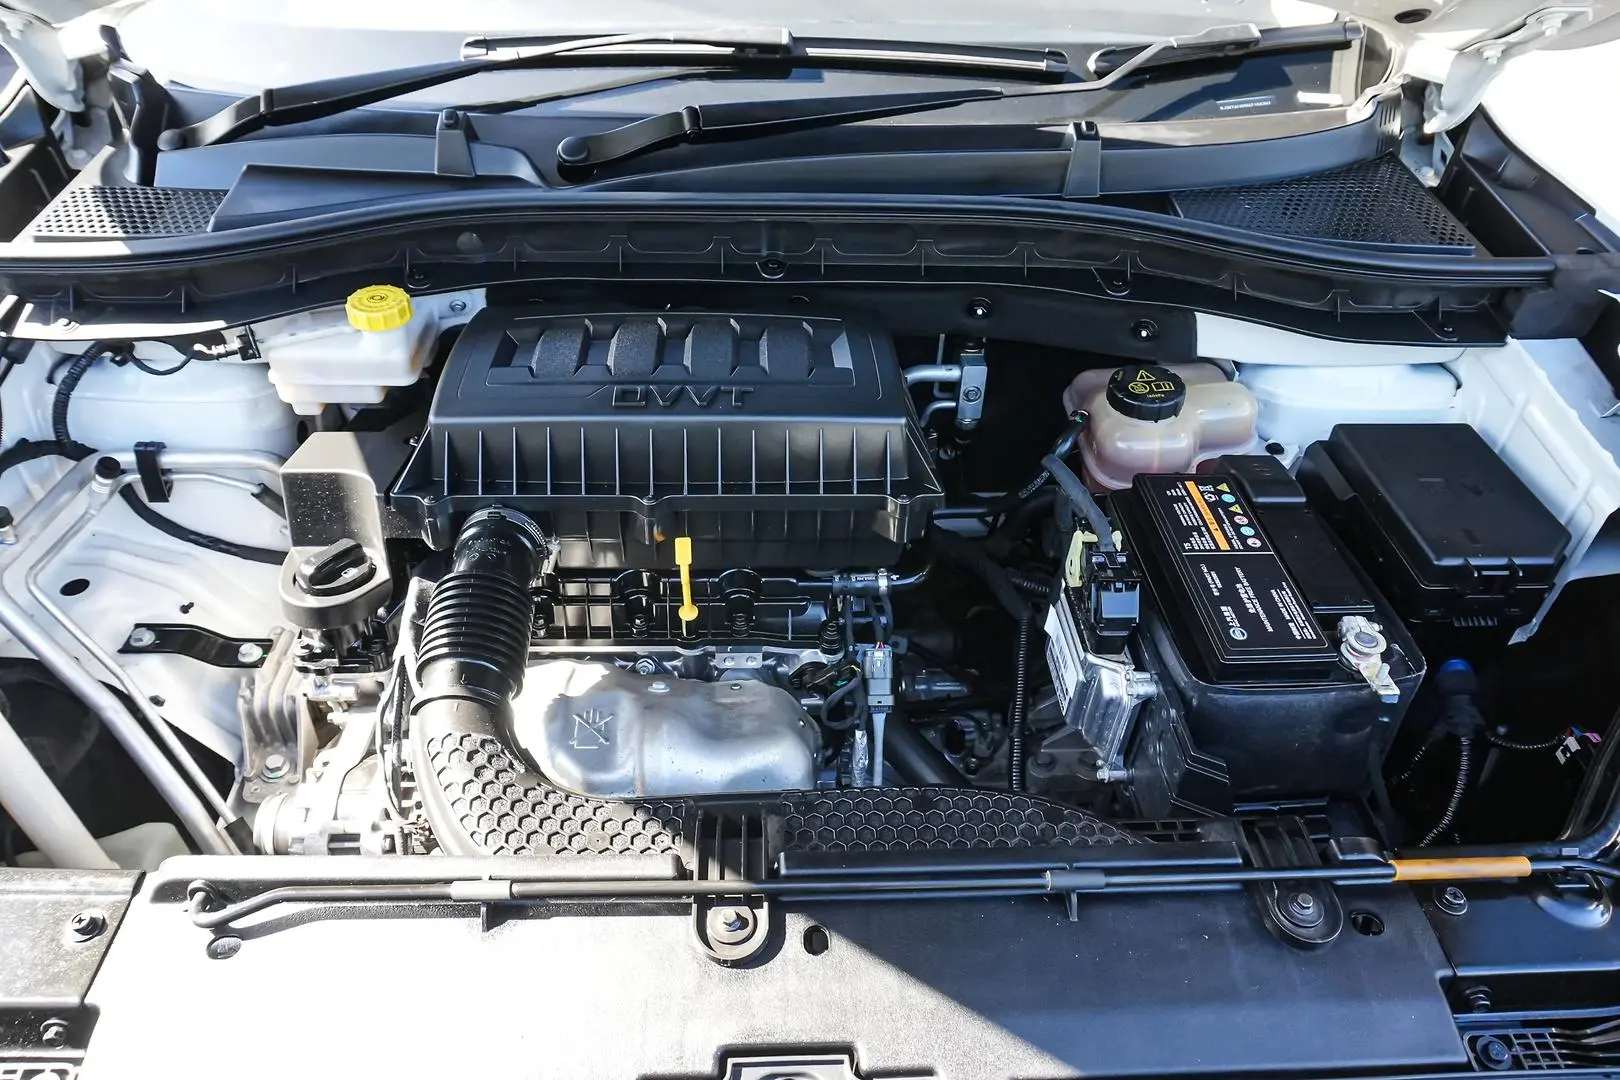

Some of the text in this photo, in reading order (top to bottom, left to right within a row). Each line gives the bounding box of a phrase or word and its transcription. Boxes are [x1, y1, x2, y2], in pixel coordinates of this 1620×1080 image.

[612, 384, 754, 408] DVVT
[1234, 566, 1249, 585] BATTERY
[1244, 586, 1256, 598] FREE
